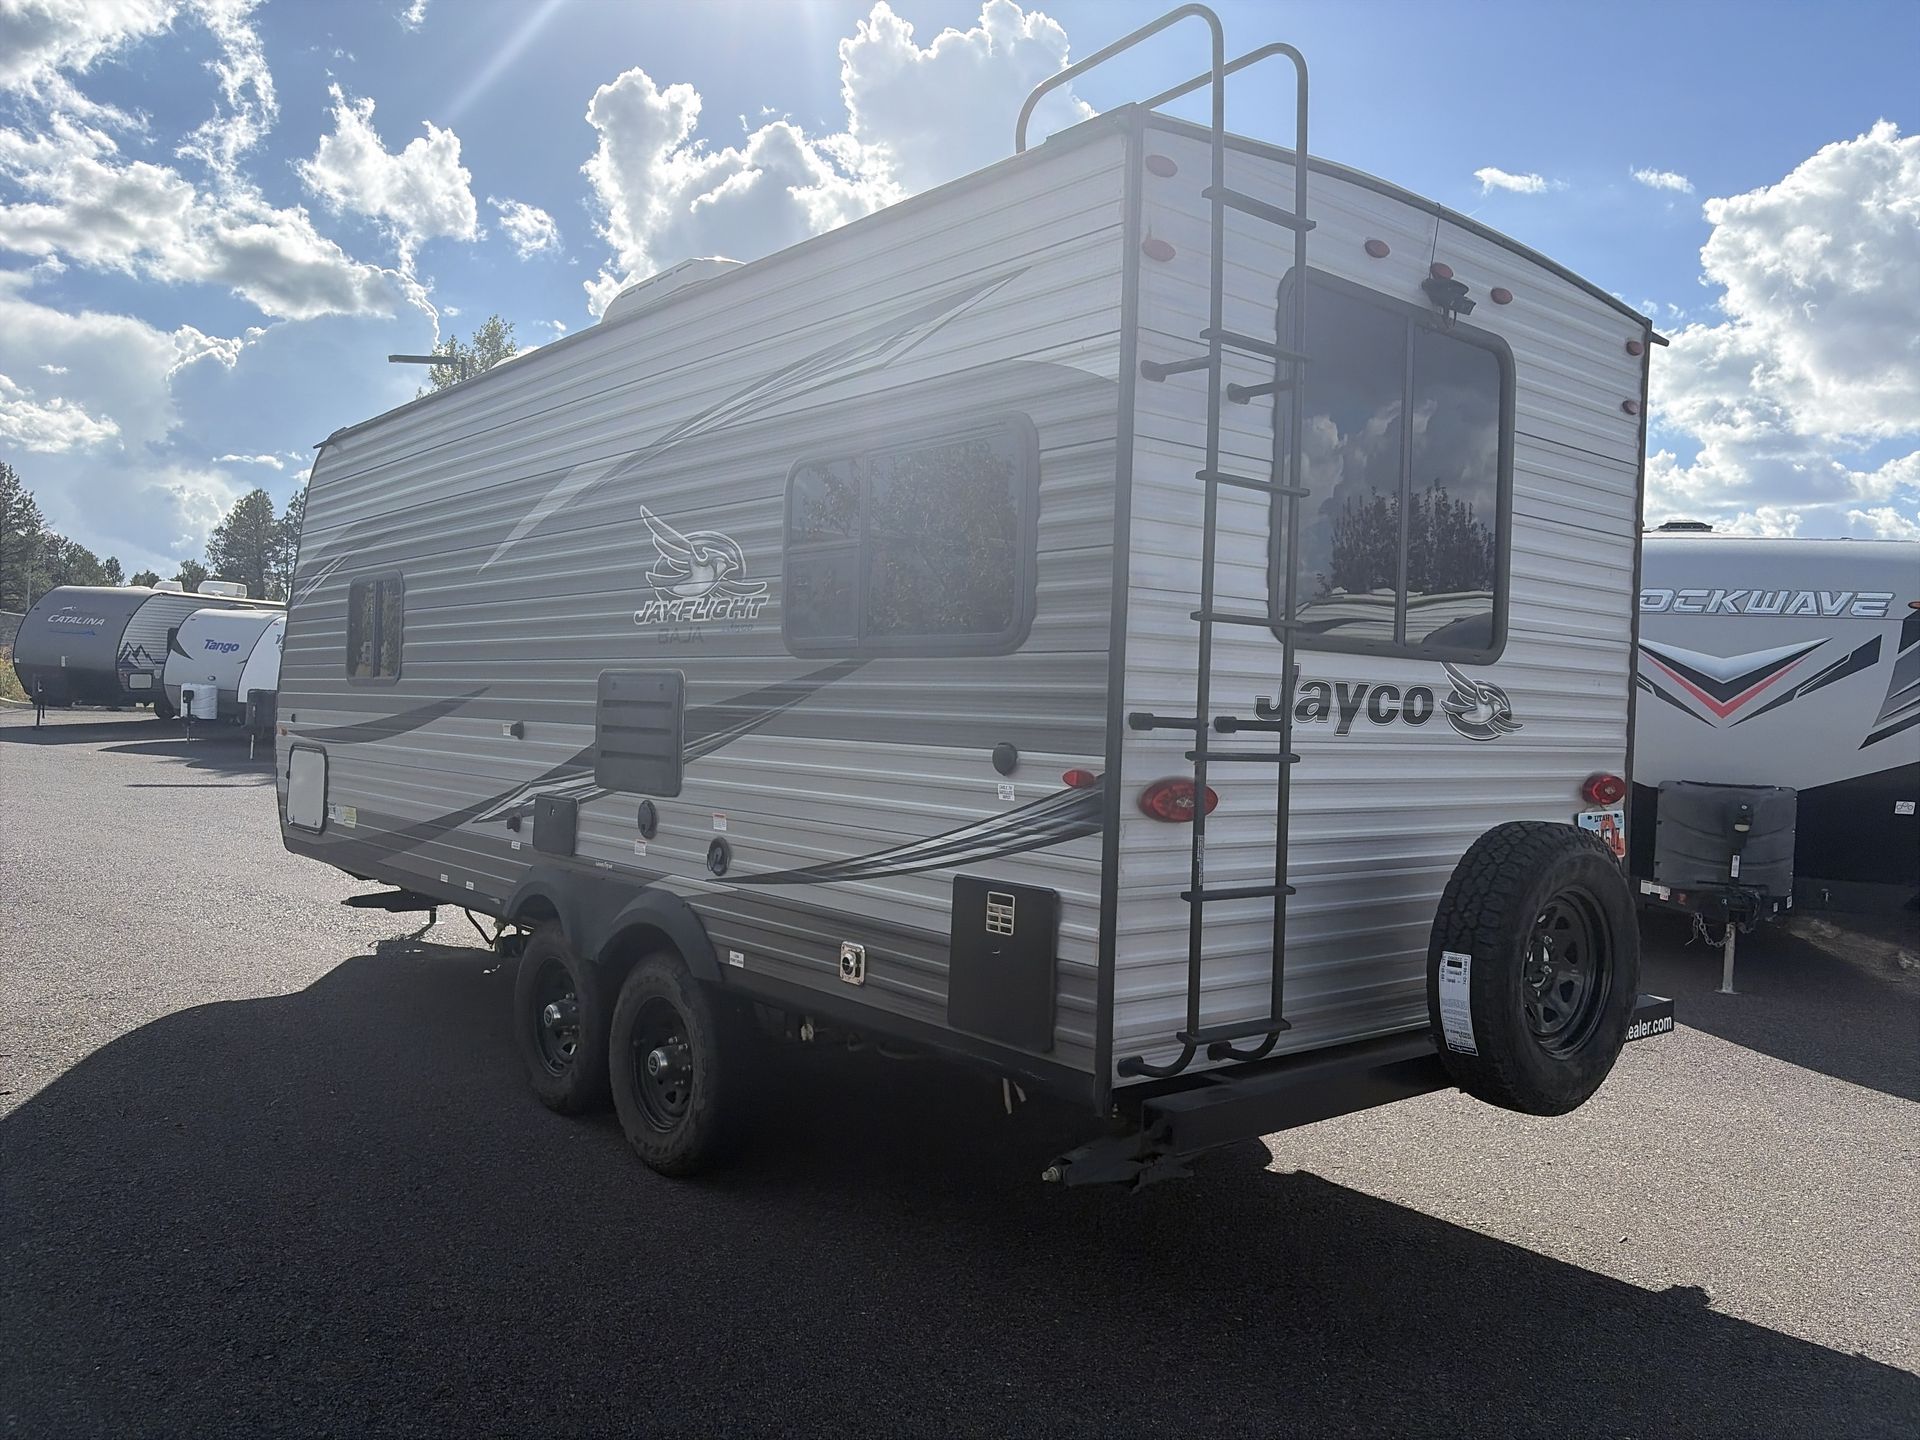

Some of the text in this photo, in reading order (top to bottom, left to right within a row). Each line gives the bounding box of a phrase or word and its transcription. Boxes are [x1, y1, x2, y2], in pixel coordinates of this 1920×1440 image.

[47, 614, 105, 626] CATALINA
[657, 626, 705, 644] BAJA
[204, 639, 240, 653] Tango
[1594, 814, 1611, 823] UTAH
[1627, 1016, 1672, 1040] ealer.com
